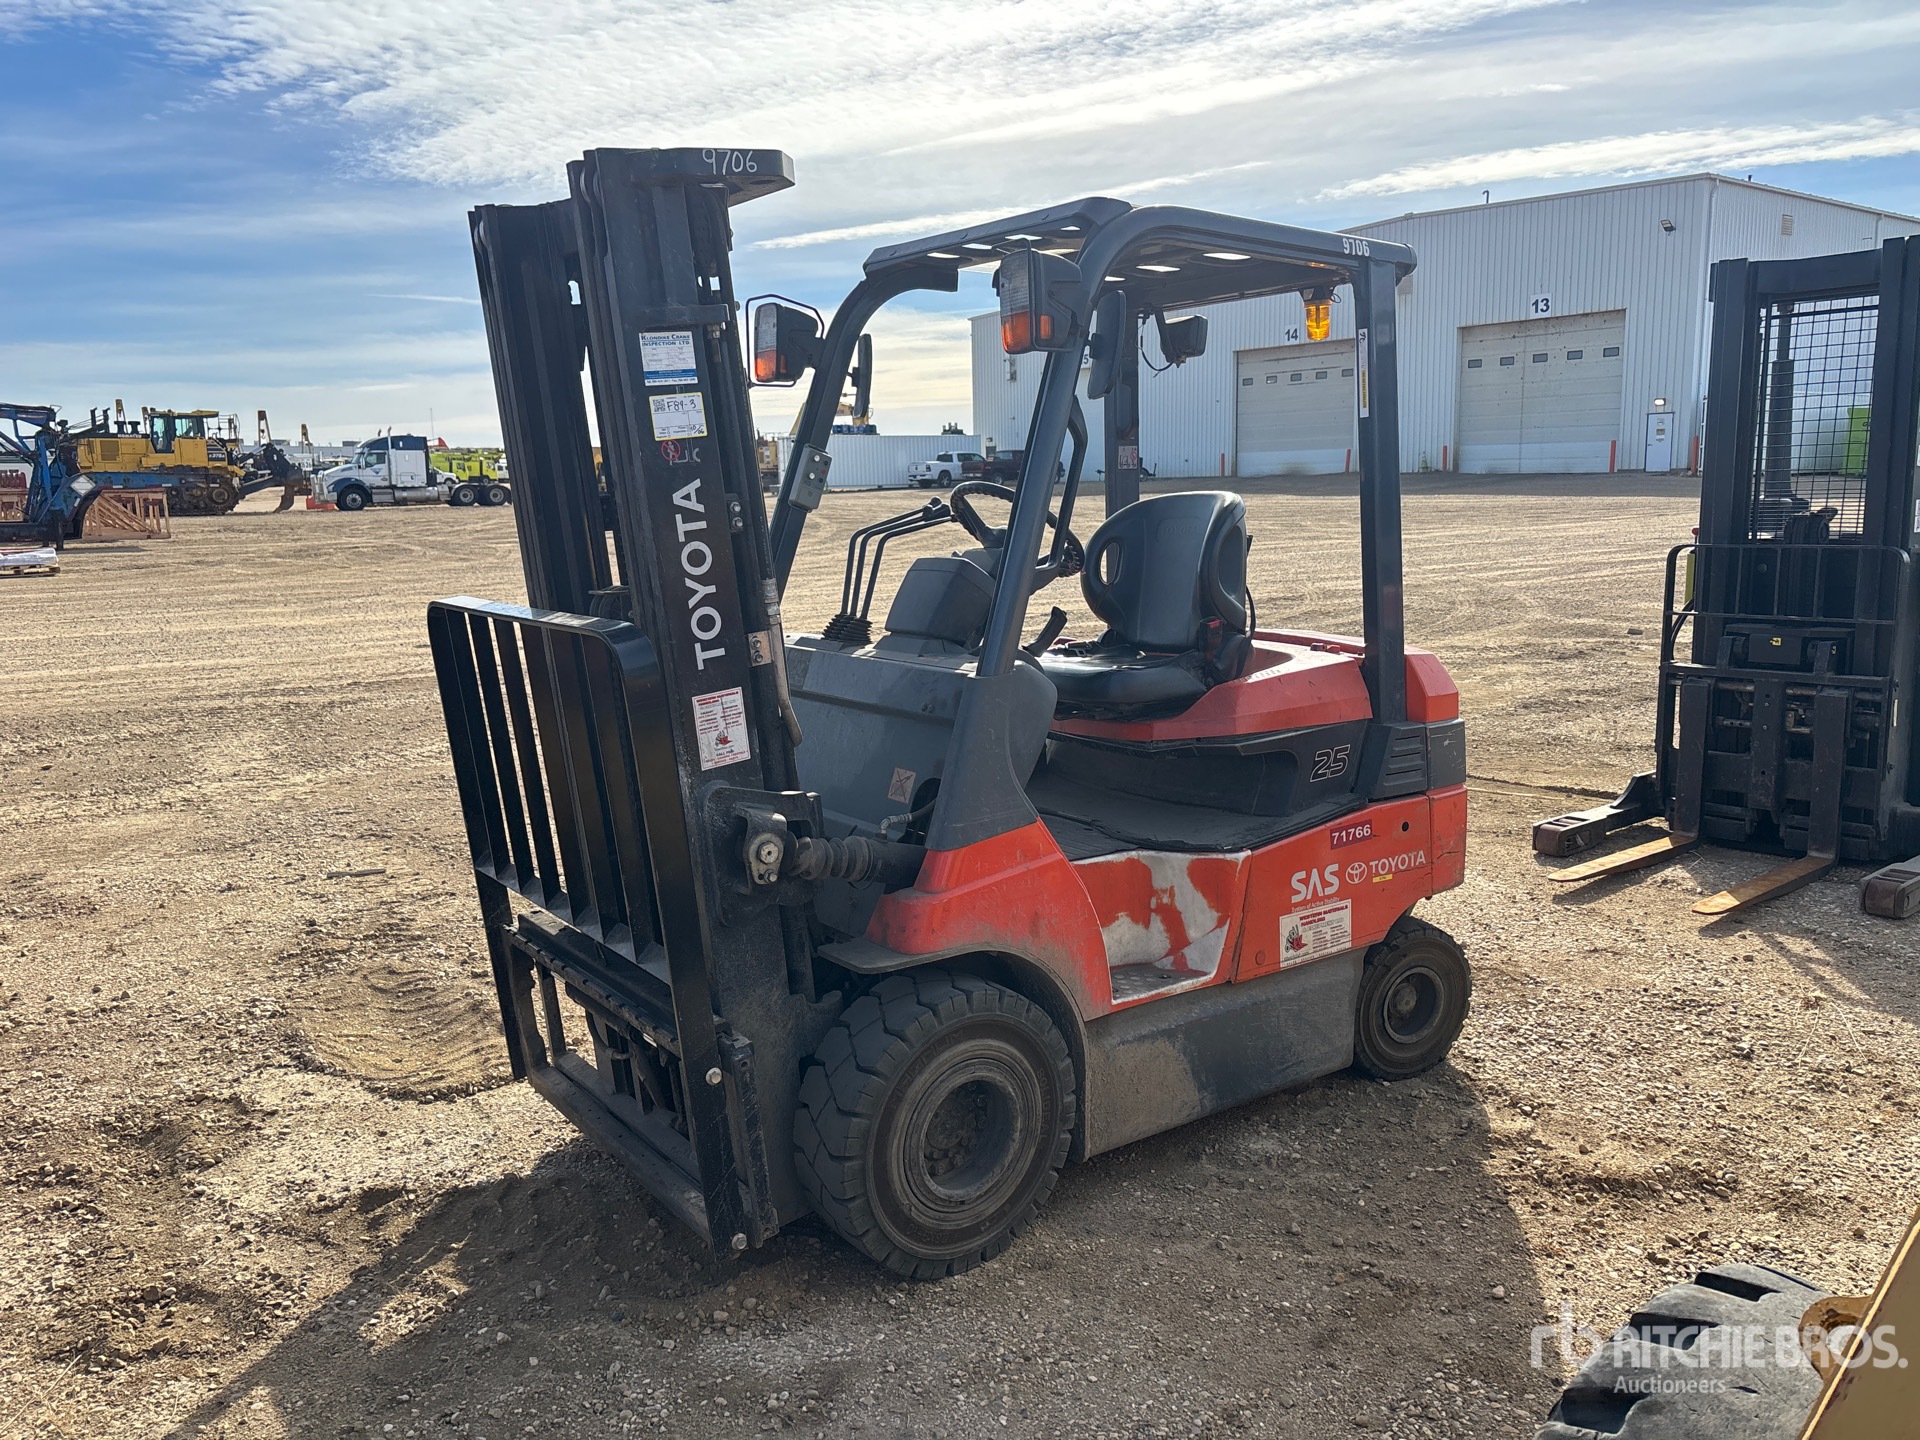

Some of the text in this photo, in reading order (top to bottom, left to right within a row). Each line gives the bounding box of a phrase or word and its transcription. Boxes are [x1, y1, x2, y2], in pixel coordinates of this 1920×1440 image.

[702, 148, 758, 176] 9706
[1342, 237, 1371, 257] 9706
[1531, 297, 1550, 314] 13
[1284, 328, 1299, 342] 14
[672, 478, 726, 671] TOYOTA
[1310, 744, 1351, 782] 25
[1331, 824, 1372, 845] 71766
[1369, 850, 1426, 876] TOYOTA
[1290, 863, 1340, 903] SAS
[1036, 1067, 1051, 1143] SOLIDEAL
